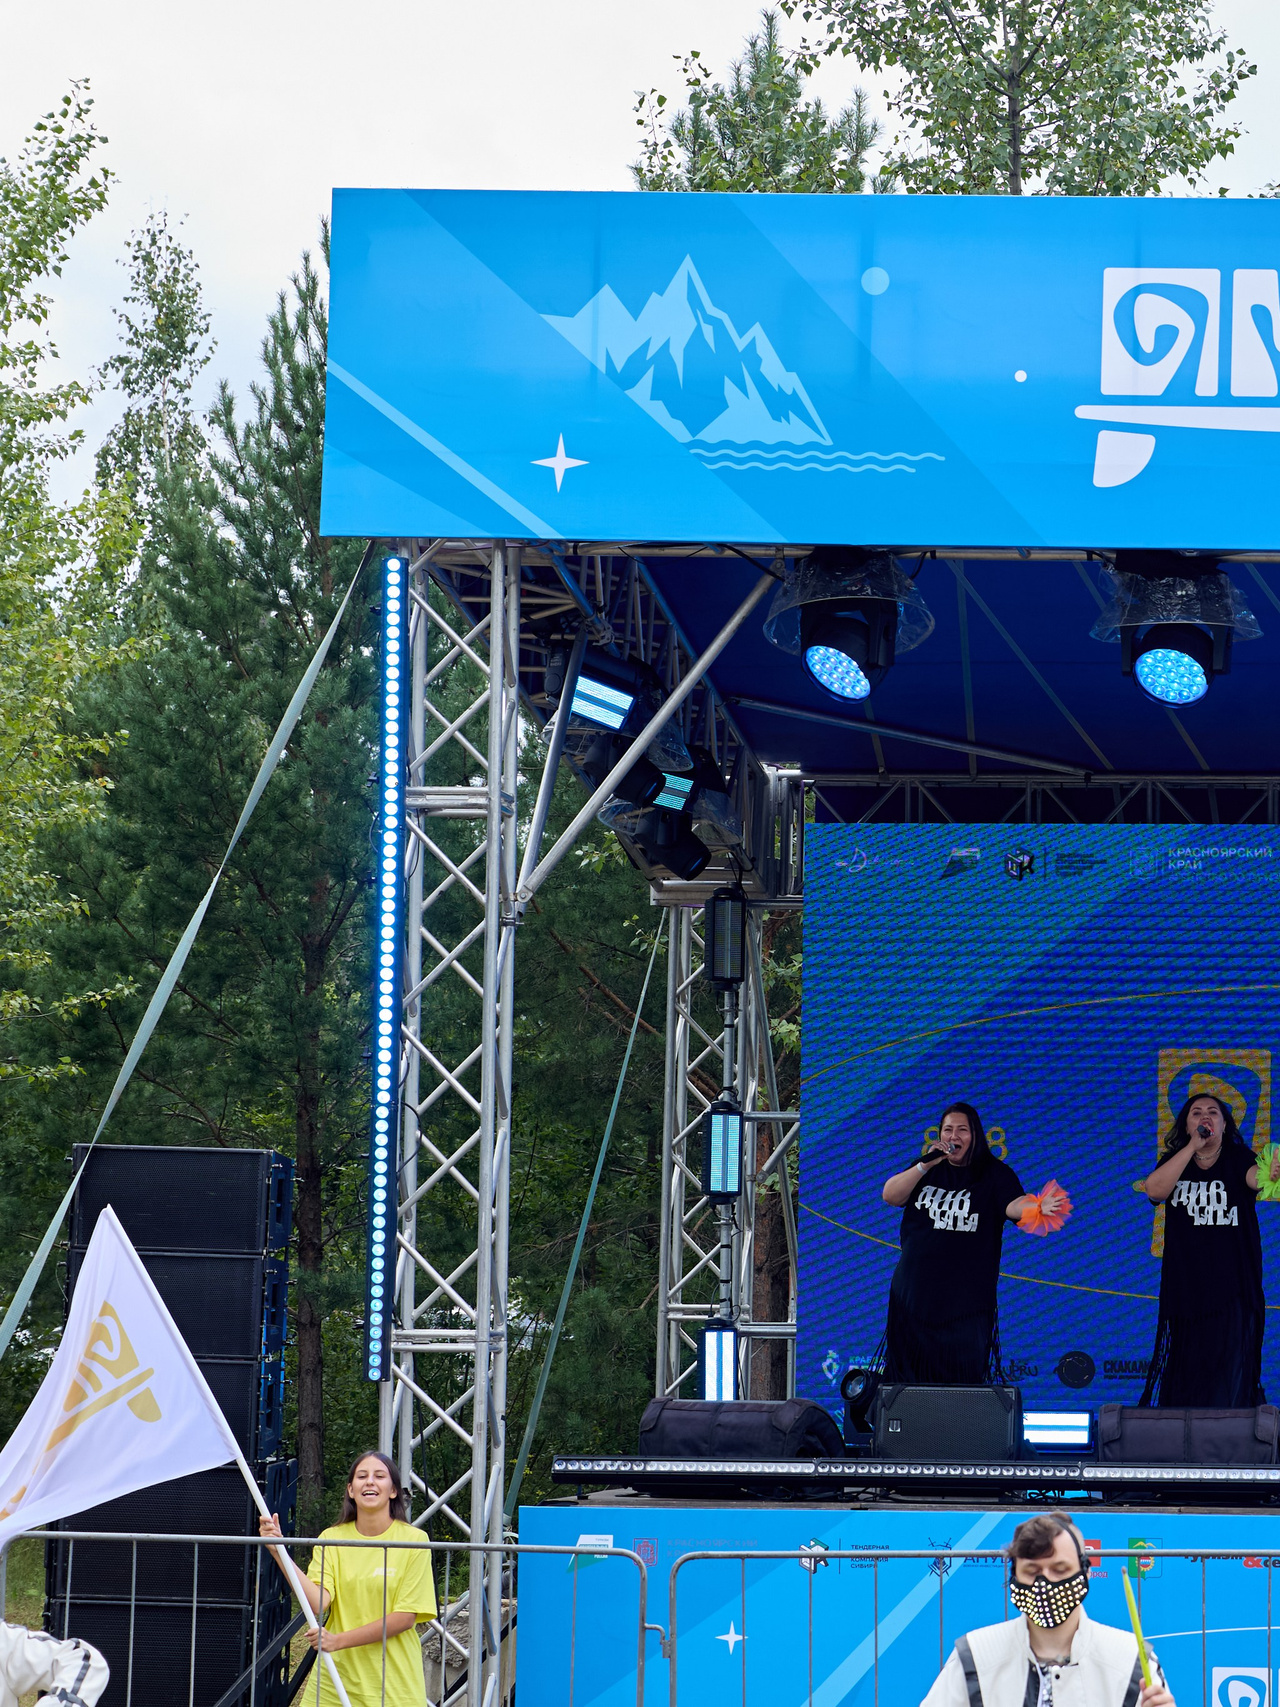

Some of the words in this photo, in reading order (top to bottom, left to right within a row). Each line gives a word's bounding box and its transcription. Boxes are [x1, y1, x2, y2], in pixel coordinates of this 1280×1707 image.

[1168, 846, 1272, 857] КРАСНОЯРСКИЙ
[1168, 858, 1202, 869] КРАЙ
[1103, 1360, 1151, 1374] СКАКАЛ
